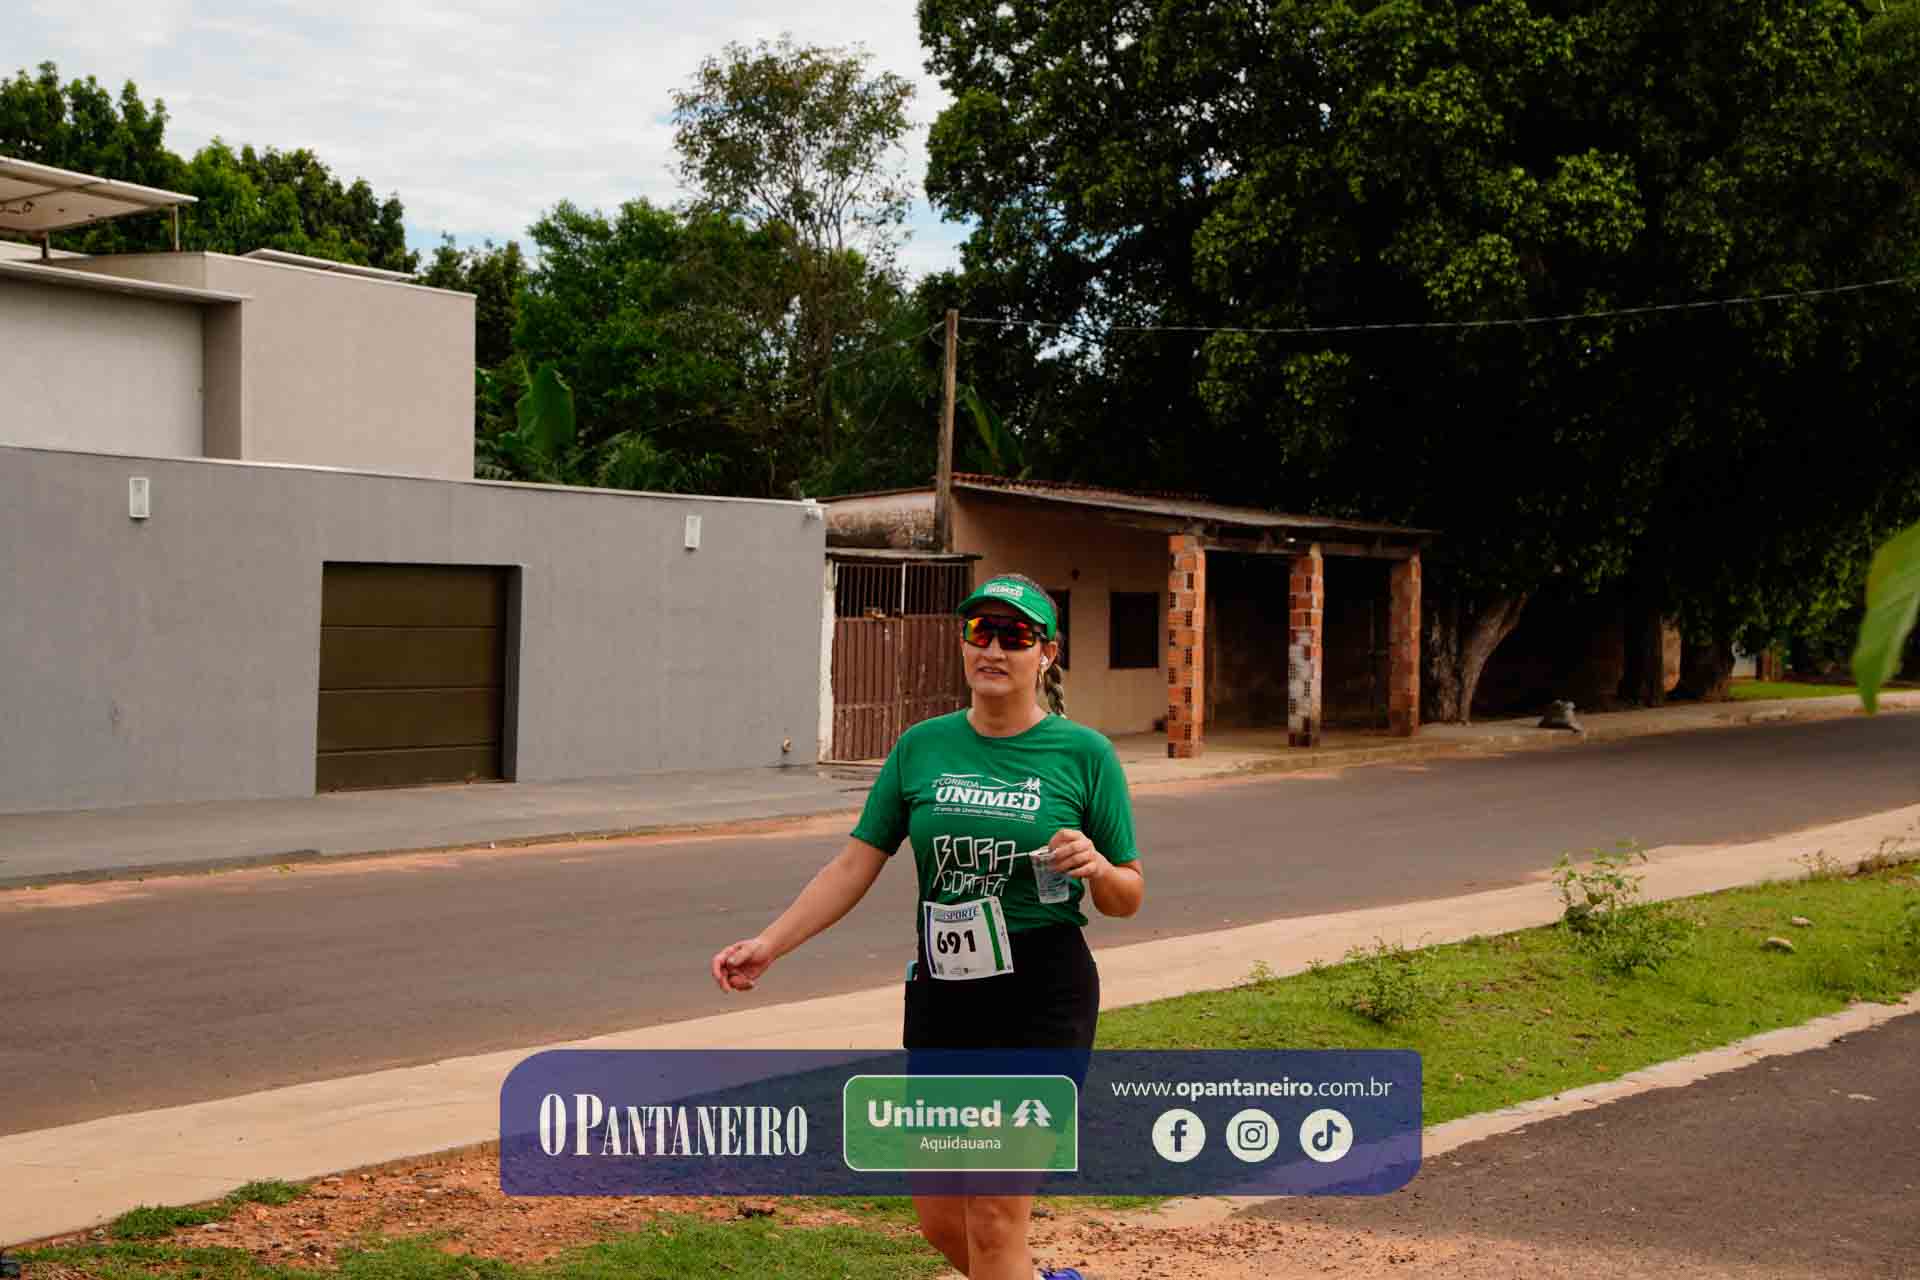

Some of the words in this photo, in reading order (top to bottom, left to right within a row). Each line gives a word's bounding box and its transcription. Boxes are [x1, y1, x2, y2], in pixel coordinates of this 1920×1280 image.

[939, 777, 980, 790] CORRIDA
[935, 786, 1041, 812] UNIMED
[933, 835, 1018, 886] BORA
[937, 929, 977, 954] 691
